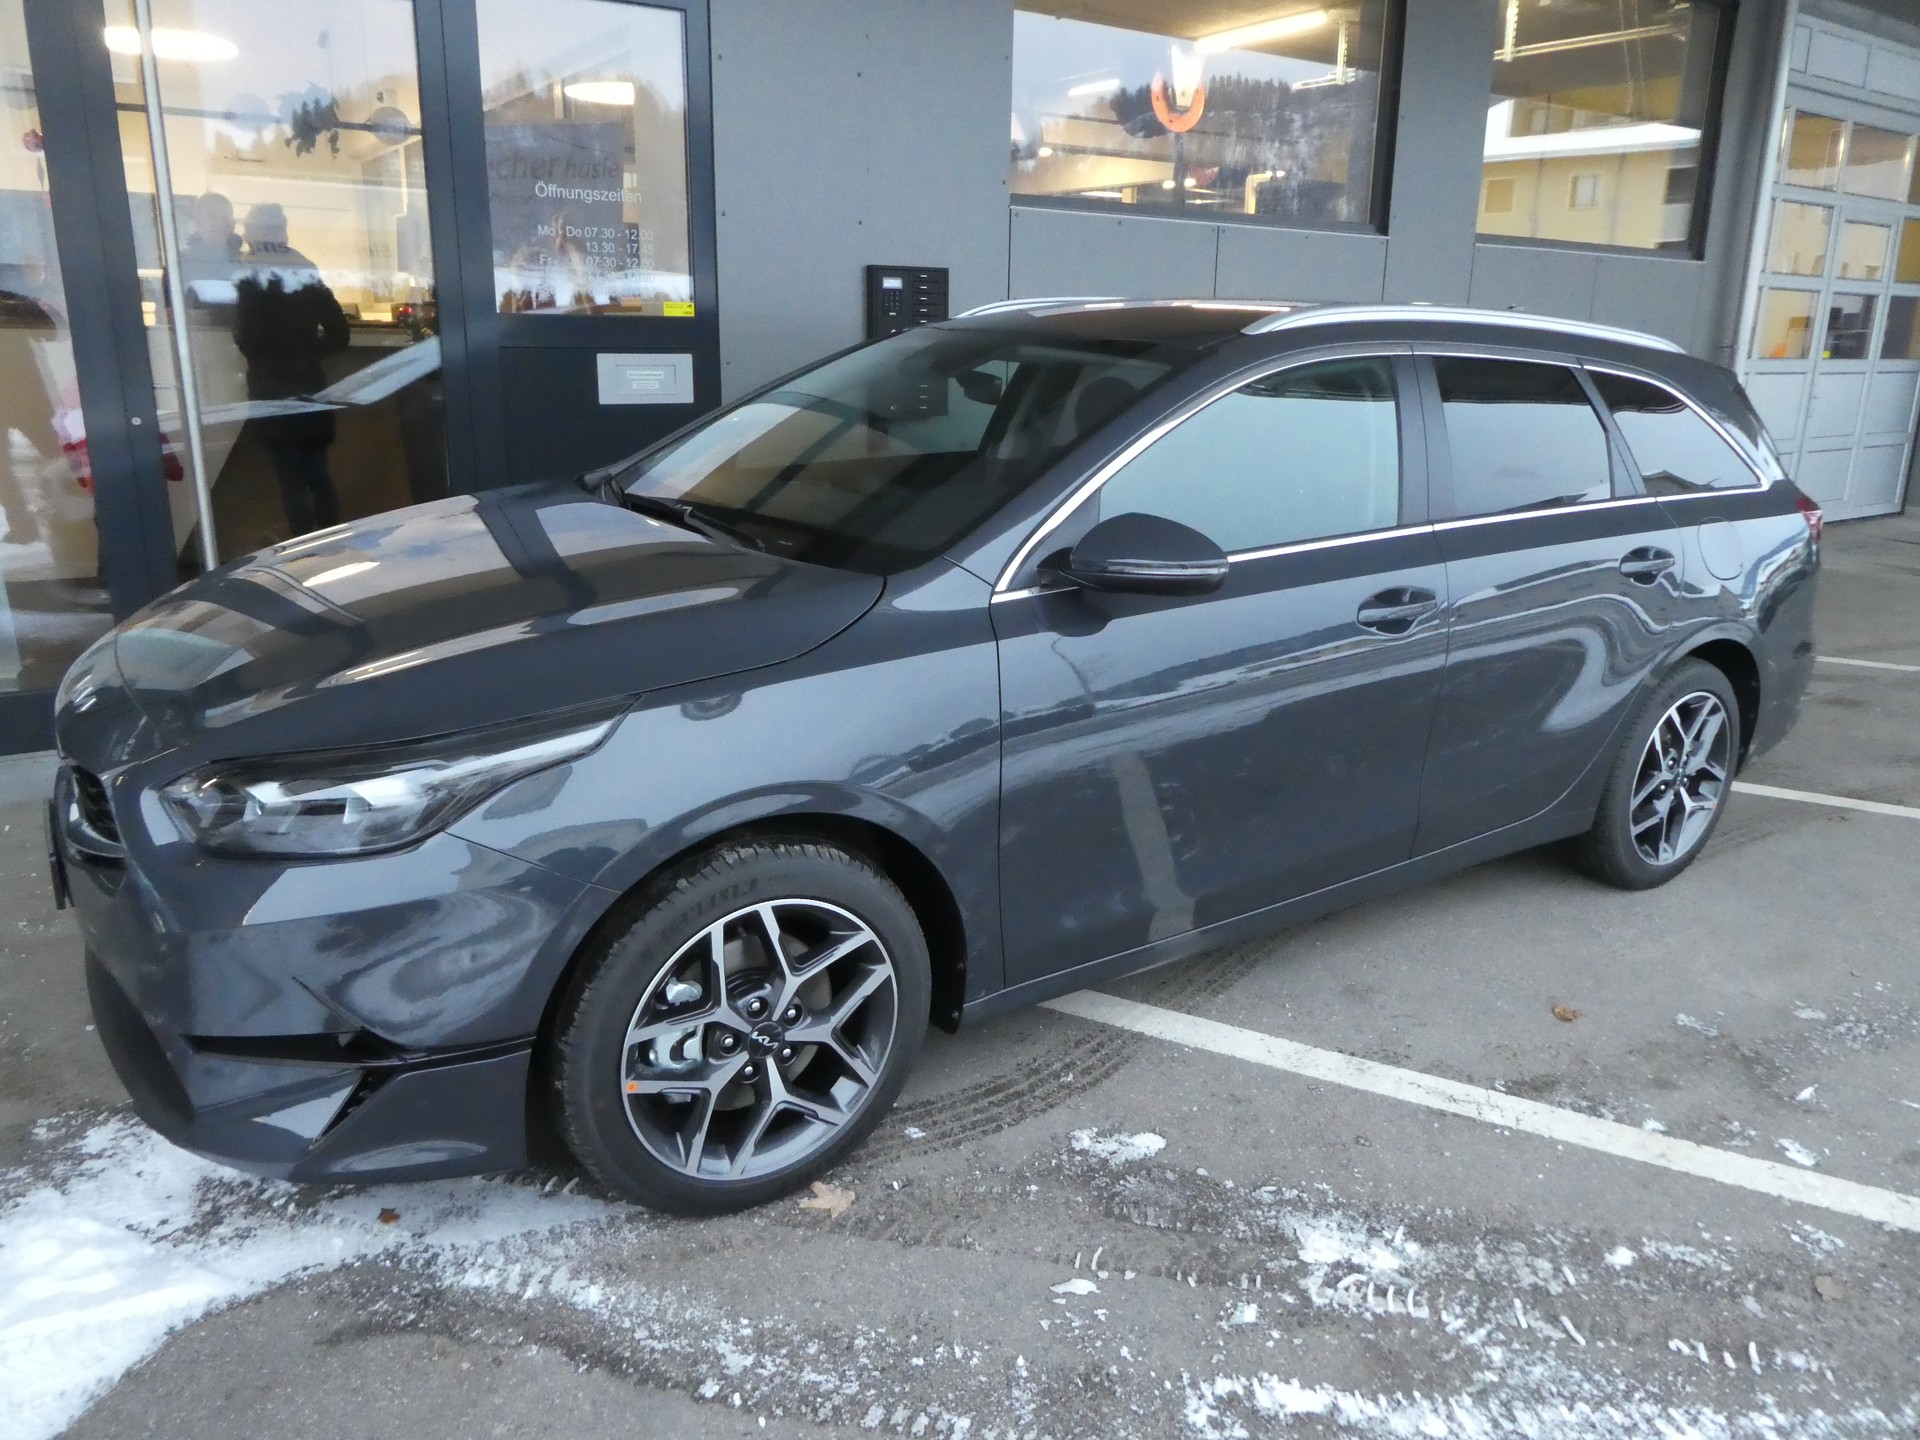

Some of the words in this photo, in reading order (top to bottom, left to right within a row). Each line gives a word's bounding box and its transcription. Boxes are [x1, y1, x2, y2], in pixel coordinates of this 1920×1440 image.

[535, 180, 642, 204] Öffnungszeiten
[537, 225, 555, 237] Mo
[566, 226, 582, 238] Do
[584, 227, 615, 239] 07.30
[624, 229, 654, 241] 12.00
[585, 242, 615, 254] 13.30
[626, 258, 655, 269] 12.00
